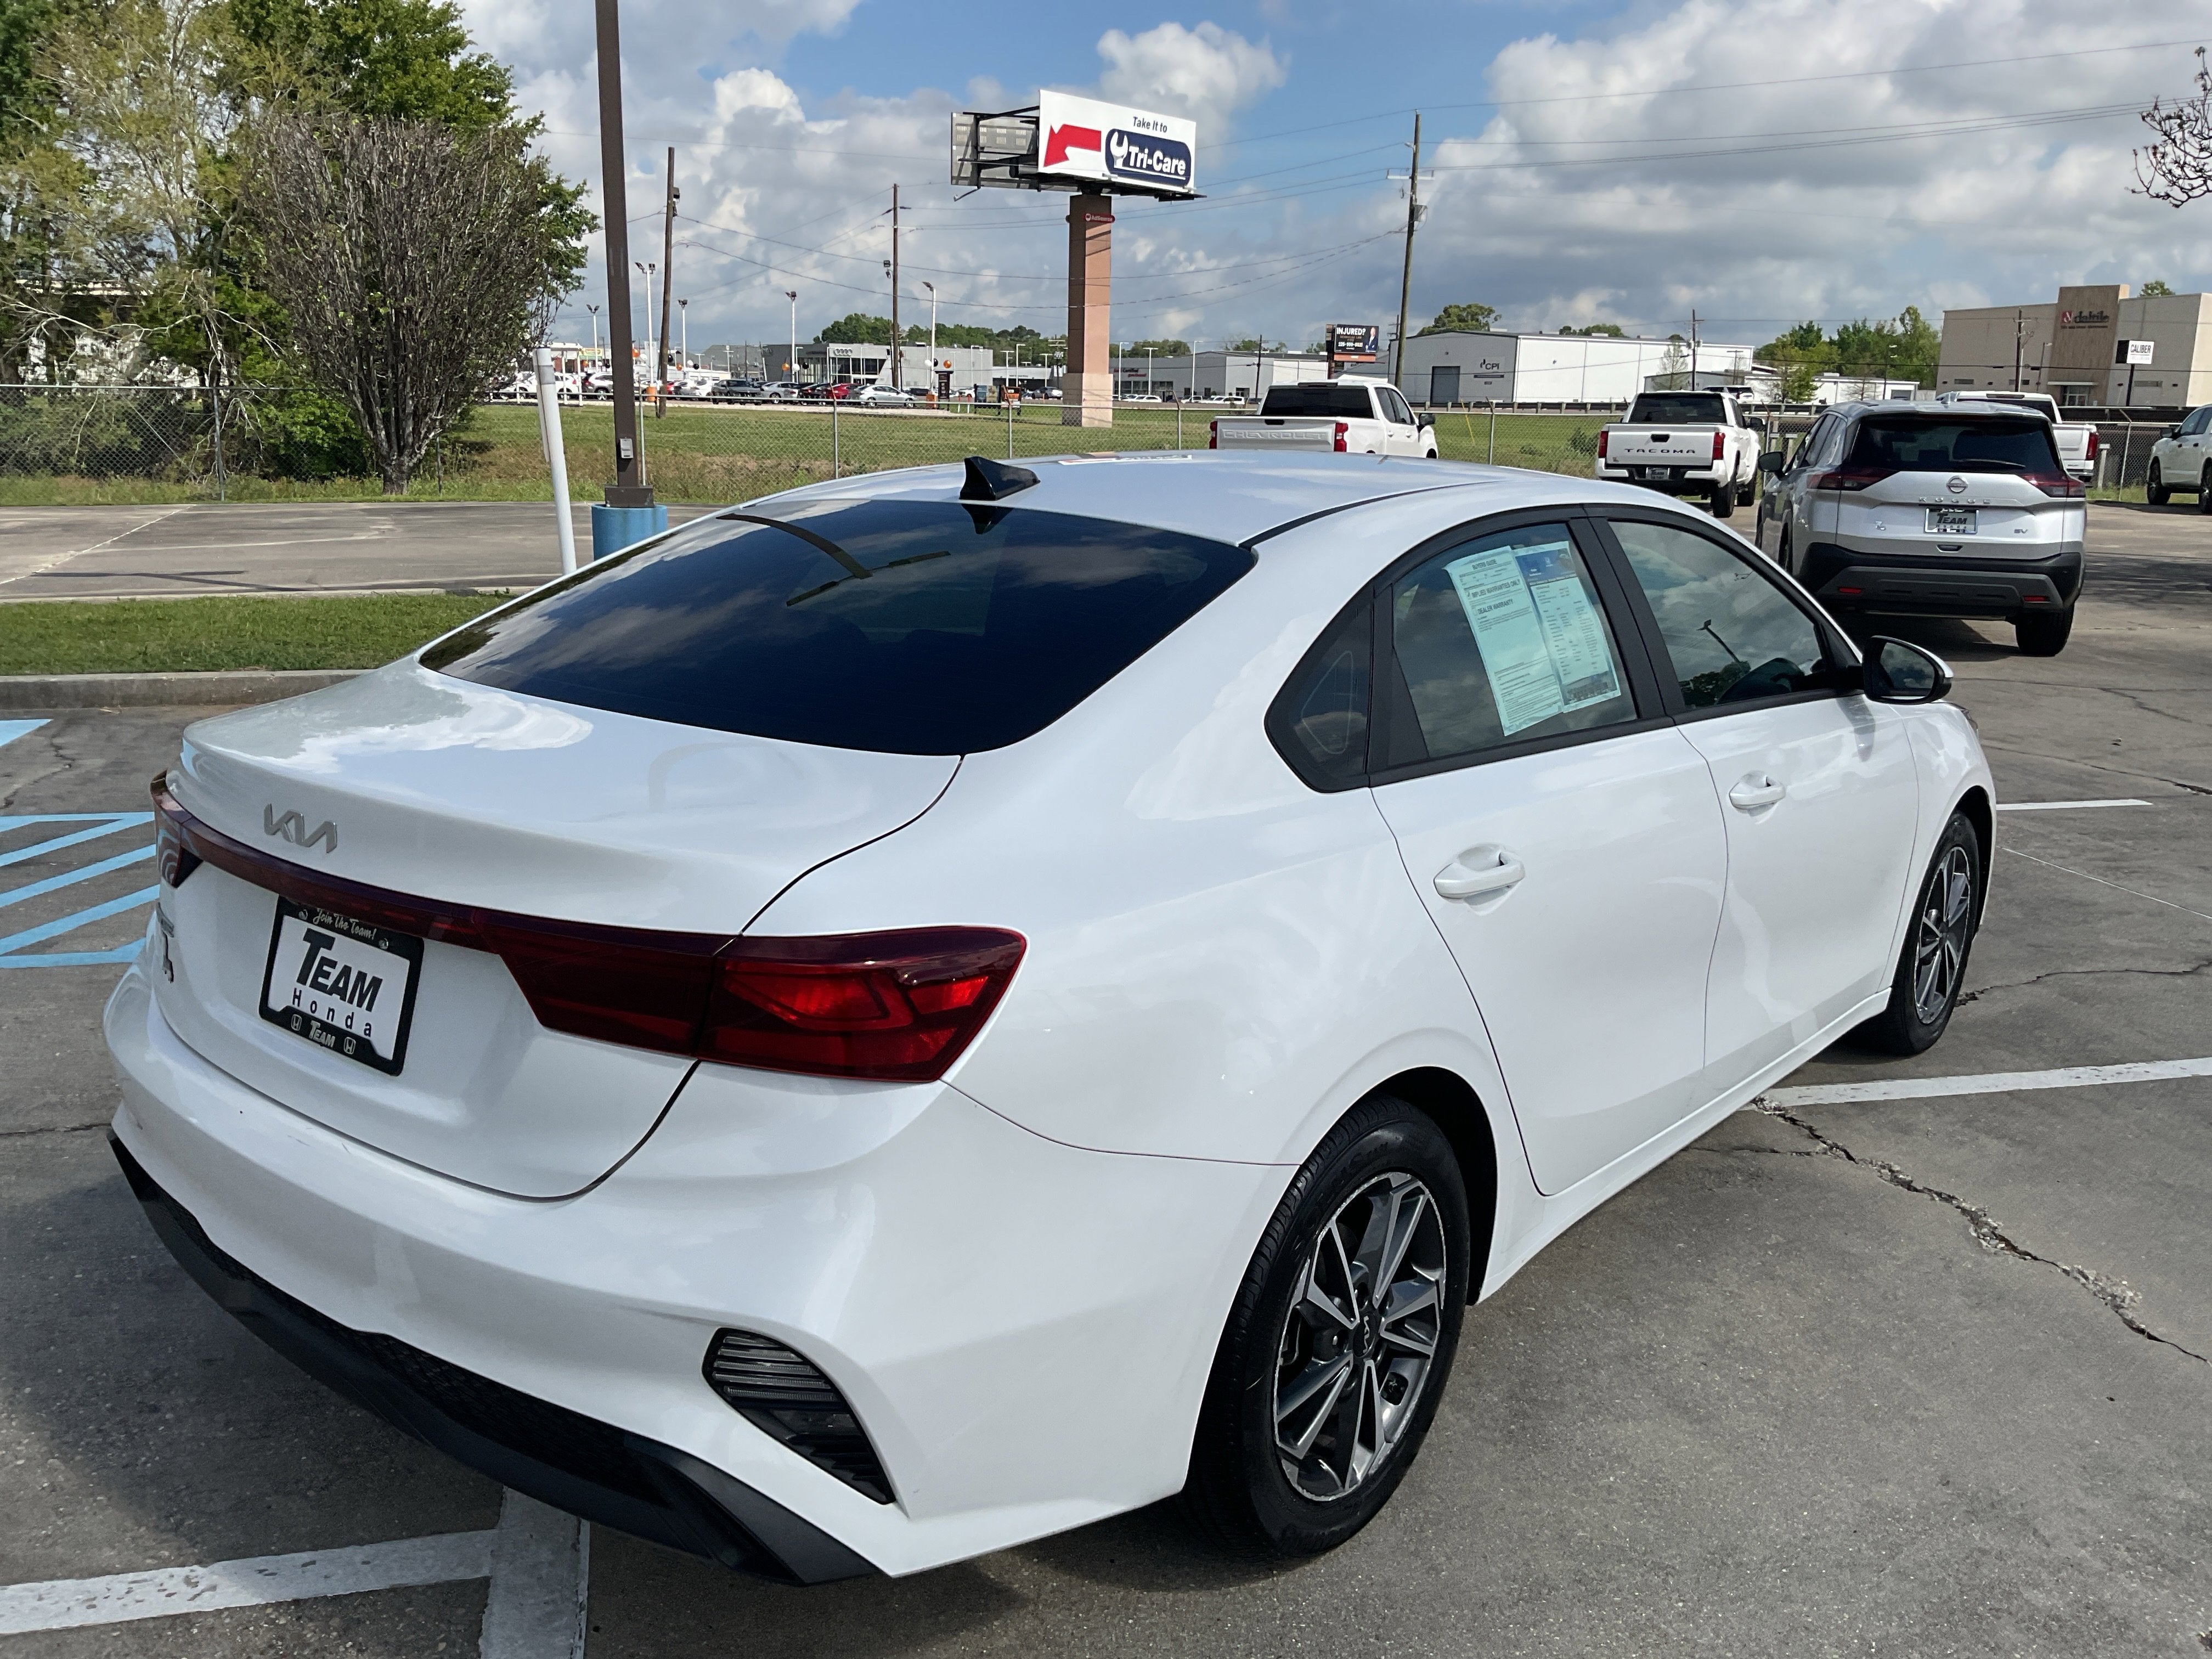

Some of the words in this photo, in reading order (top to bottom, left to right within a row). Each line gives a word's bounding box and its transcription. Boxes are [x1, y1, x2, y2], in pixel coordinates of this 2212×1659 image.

[1133, 116, 1151, 129] Take
[1160, 122, 1167, 133] to
[1128, 145, 1186, 175] Tri-Care
[1336, 327, 1366, 336] INJURED?
[2130, 344, 2151, 353] CALIBER
[1223, 430, 1326, 439] CHEVROLET
[1937, 513, 1968, 524] TEAM
[1471, 589, 1487, 598] IMPLIED
[1486, 582, 1511, 594] WARRANTIES
[1510, 579, 1520, 587] ONLY
[1477, 605, 1493, 614] DEALER
[1492, 599, 1514, 610] WARRANTY
[313, 907, 333, 925] Join
[333, 912, 349, 930] The
[349, 918, 377, 940] Team!
[296, 928, 383, 1013] TEAM
[292, 987, 372, 1037] Honda
[308, 1020, 335, 1048] TEAM
